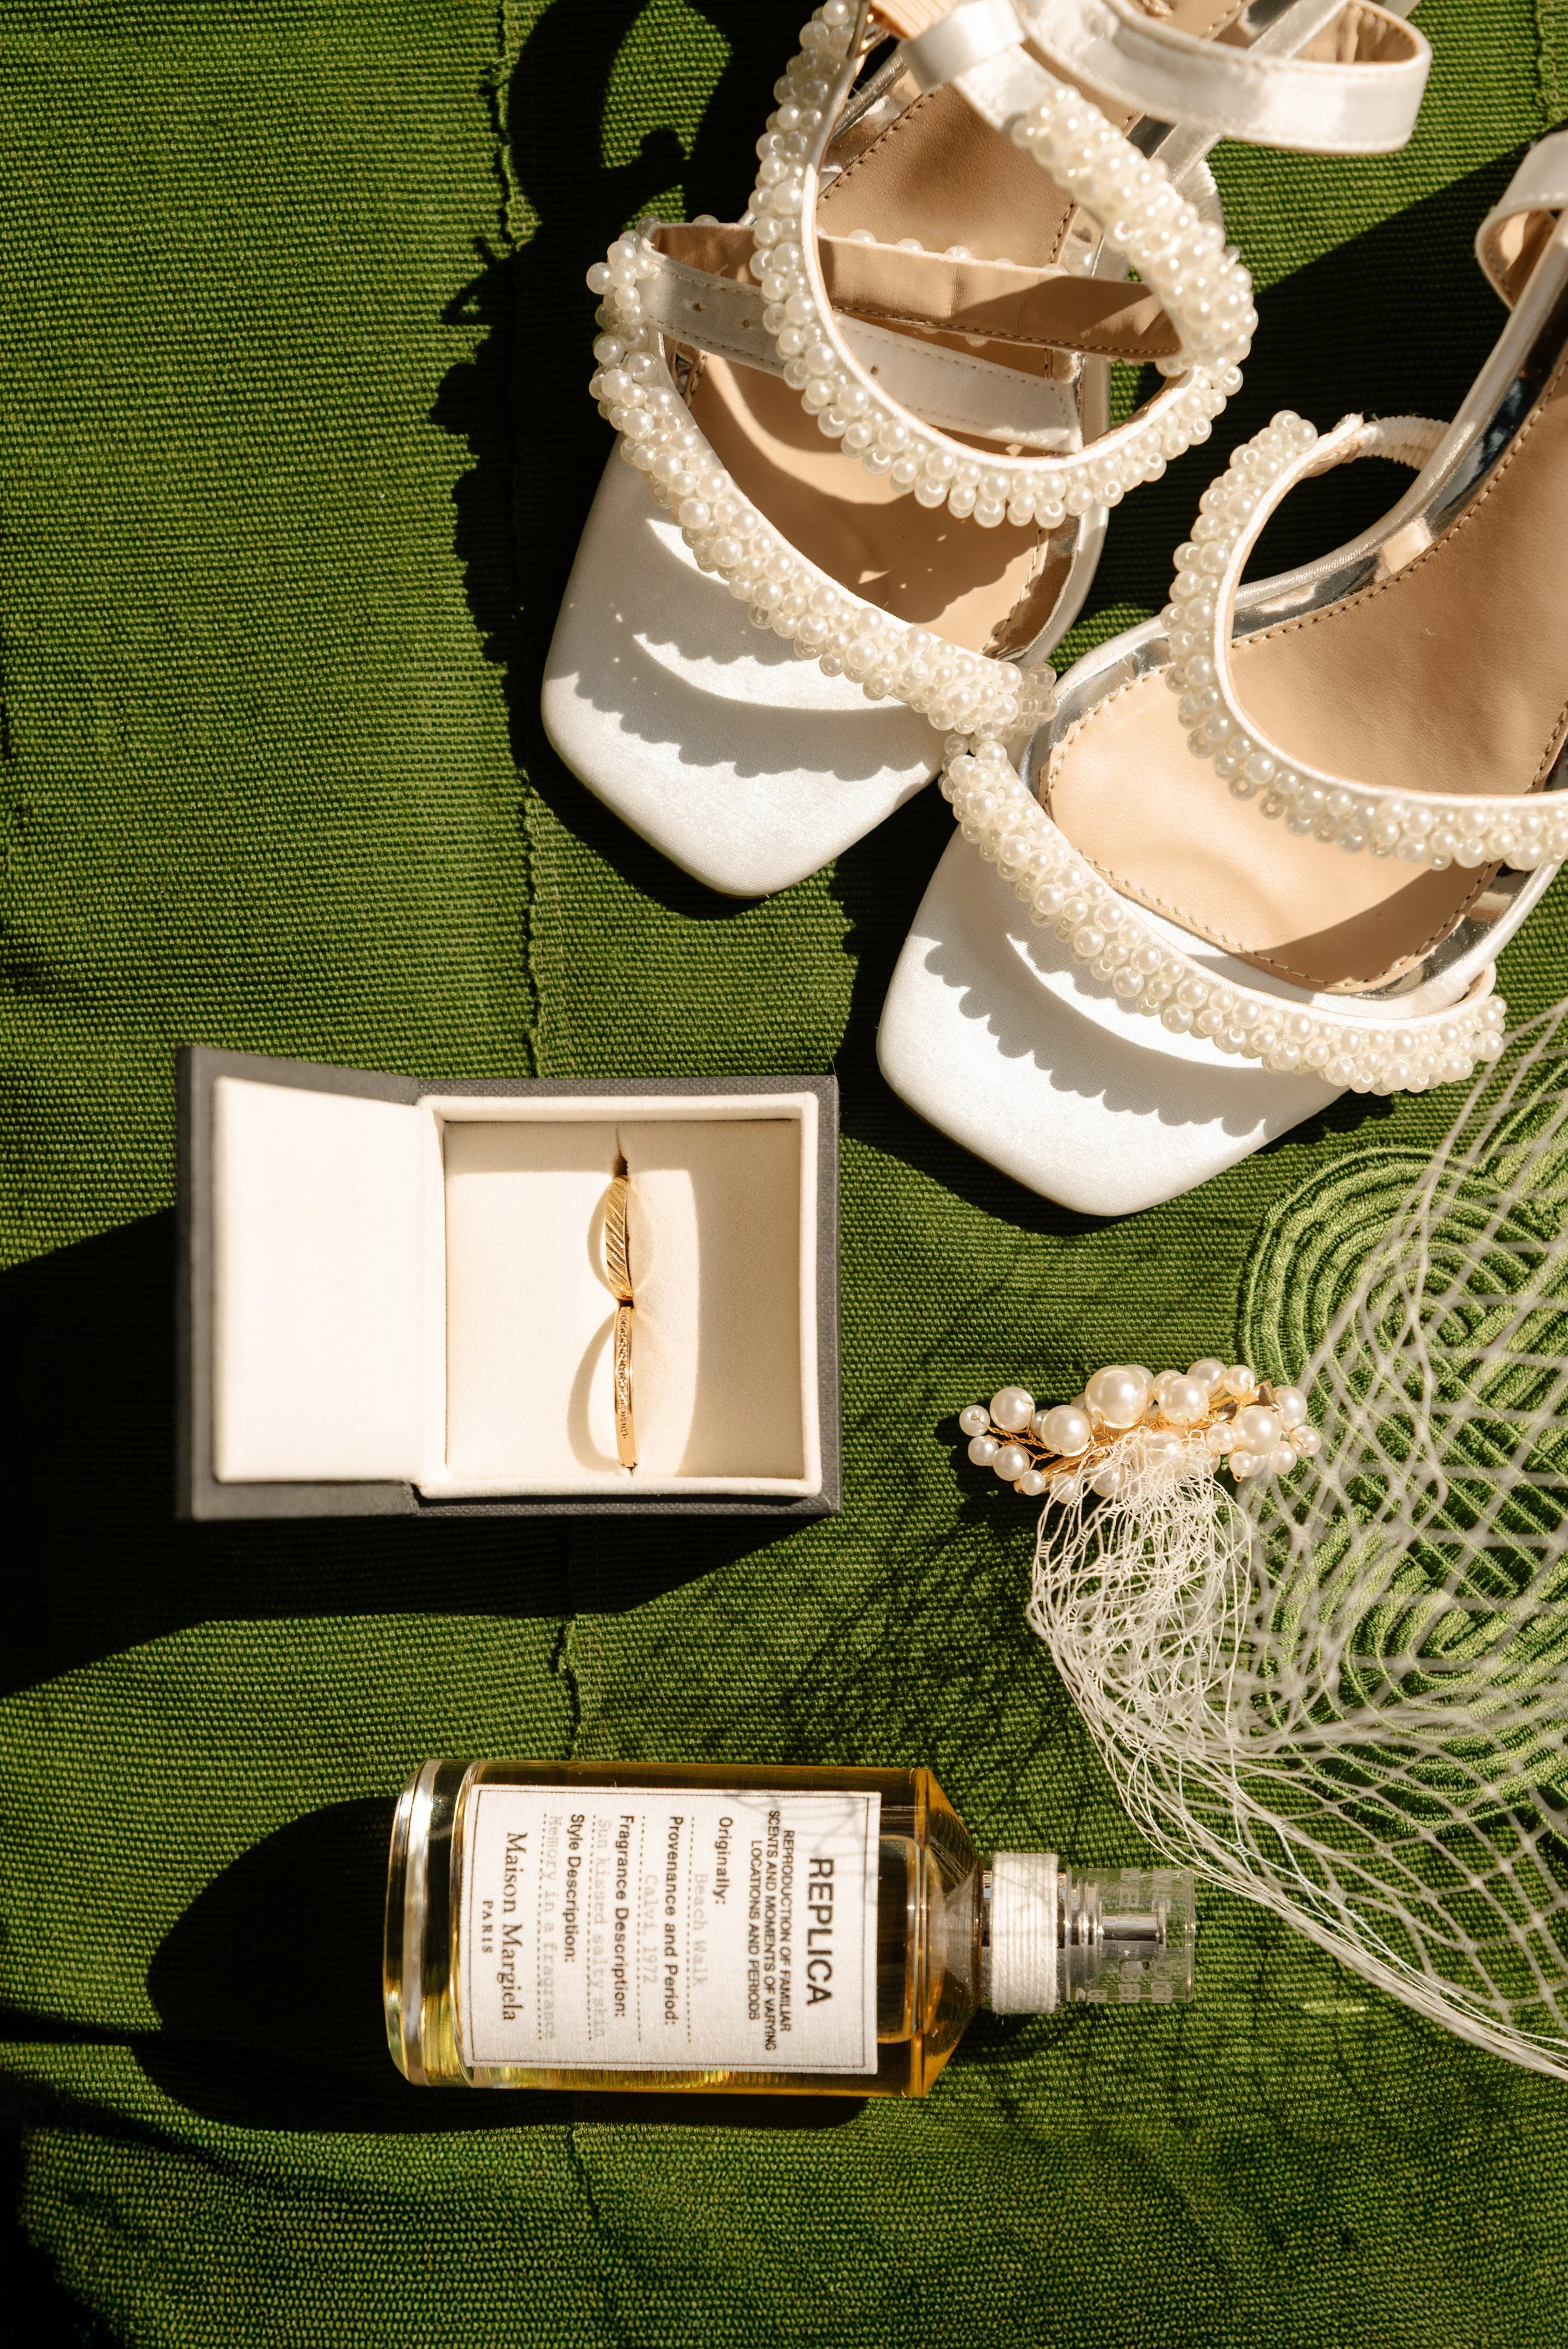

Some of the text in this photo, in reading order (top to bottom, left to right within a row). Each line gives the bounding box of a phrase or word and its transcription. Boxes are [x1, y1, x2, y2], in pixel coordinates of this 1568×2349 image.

[482, 1900, 494, 1954] PARIS
[497, 1832, 528, 2021] Maison Margiela
[539, 1815, 563, 2039] Memory in a fragrance
[563, 1813, 585, 1962] Style Description:
[590, 1819, 612, 2037] Sun kissed salty skin
[612, 1815, 634, 2017] Fragrance Description:
[664, 1816, 684, 2025] Provenance and Period:
[692, 1874, 708, 1986] Beach Walk
[713, 1817, 734, 1905] Originally:
[748, 1840, 763, 2021] LOCATIONS AND PERIODS
[764, 1810, 780, 2050] SCENTS AND MOMENTS OF VARYING
[780, 1830, 795, 2032] REPRODUCTION OF FAMILIAR
[807, 1859, 834, 2006] REPLICA
[644, 1946, 658, 1983] 1972
